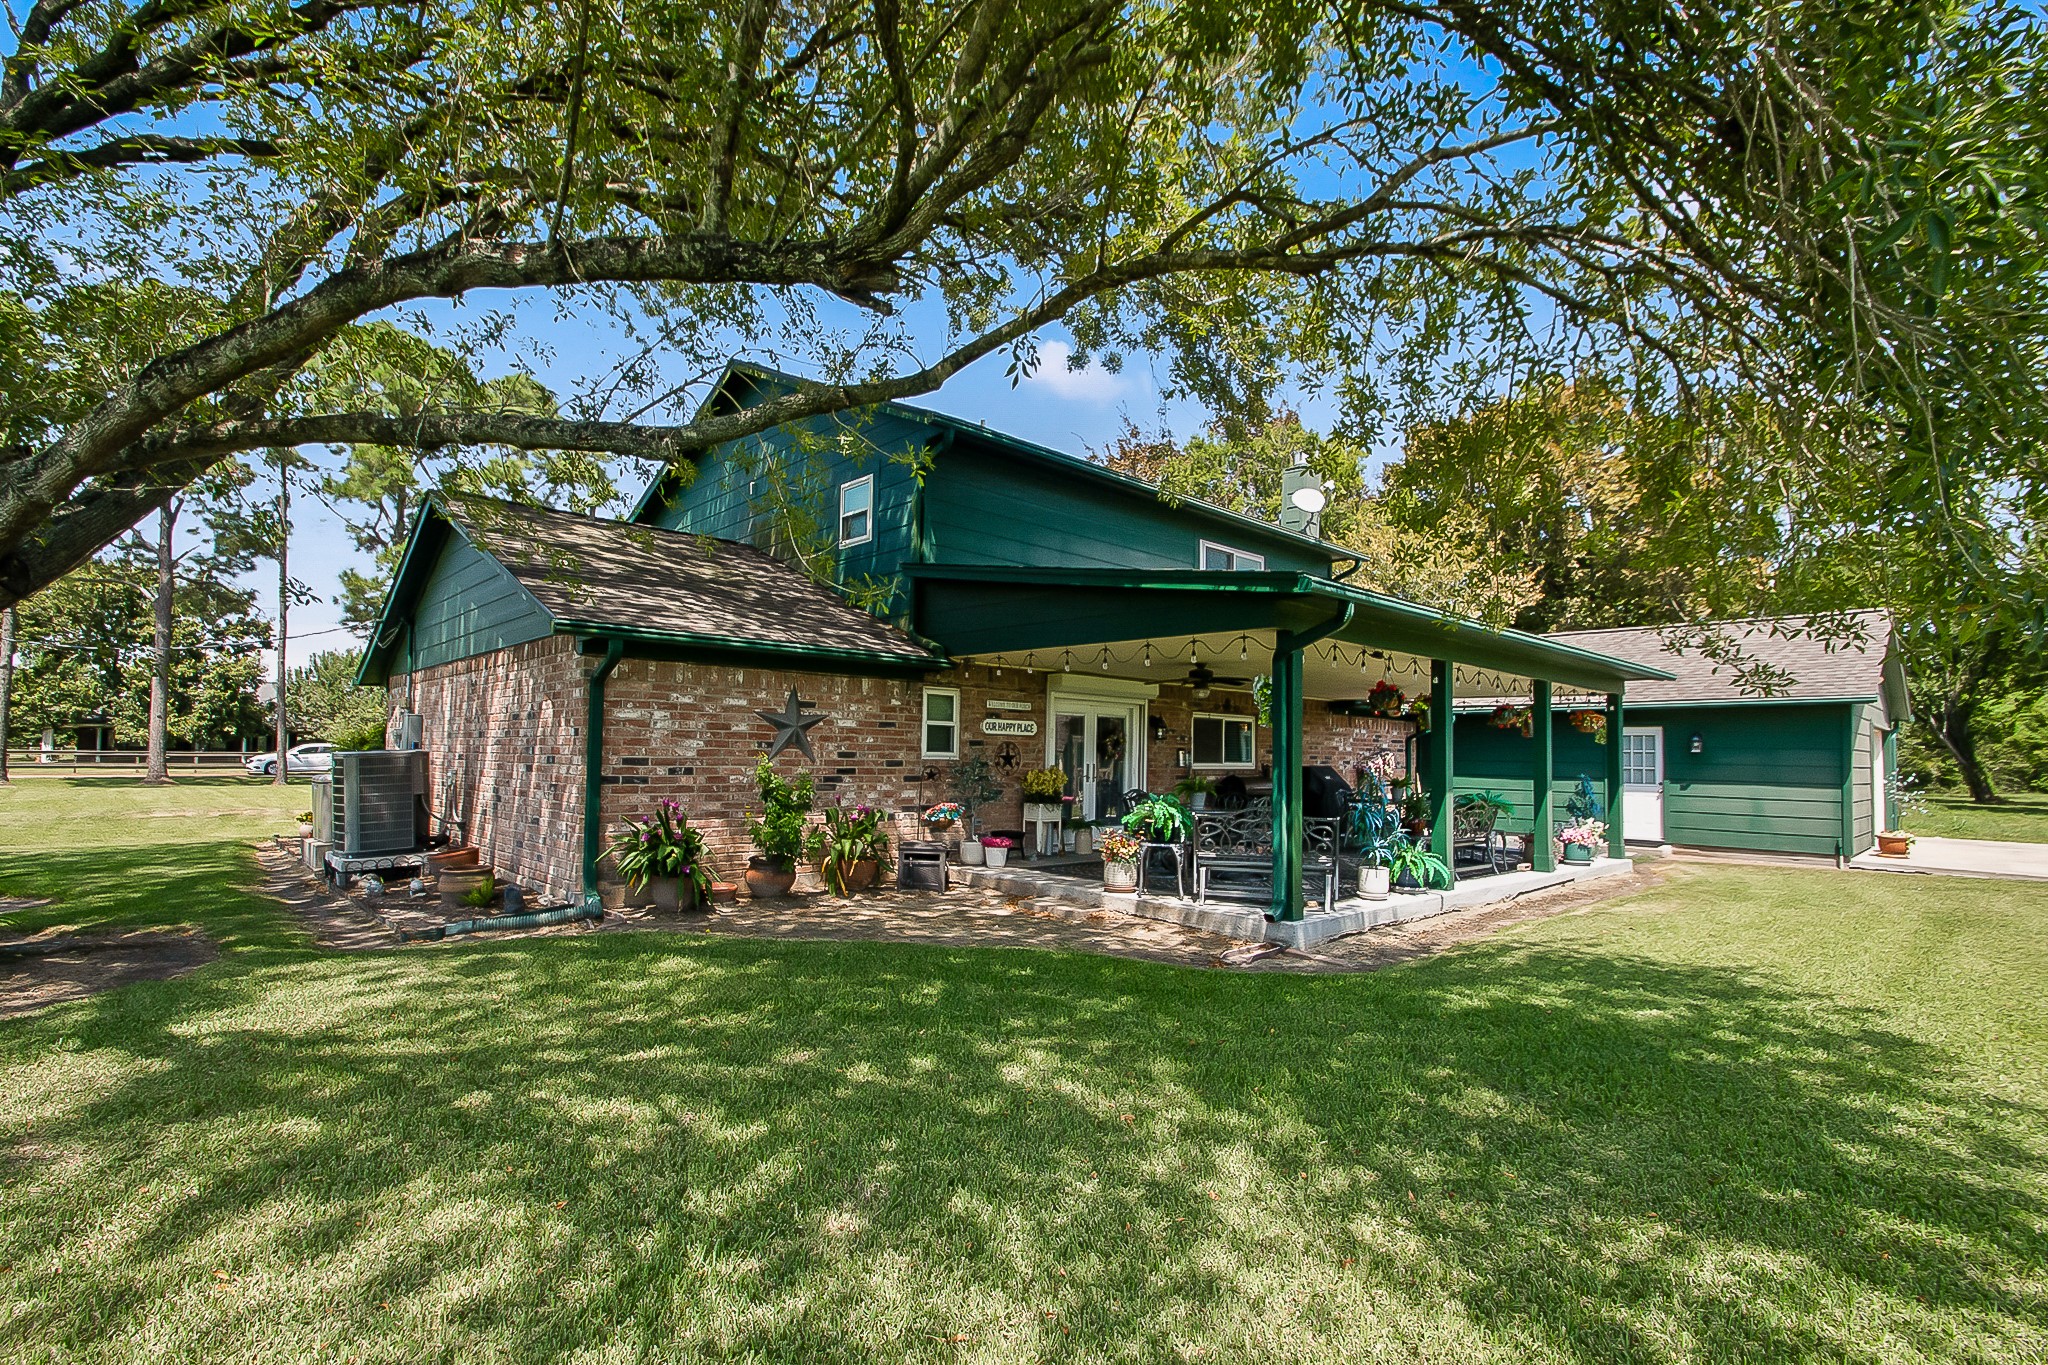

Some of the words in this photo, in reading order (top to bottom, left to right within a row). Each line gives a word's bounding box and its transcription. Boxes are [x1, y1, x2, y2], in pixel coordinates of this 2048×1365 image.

[985, 722, 997, 731] OUR
[998, 722, 1016, 732] HAPPY
[1016, 723, 1034, 733] PLACE
